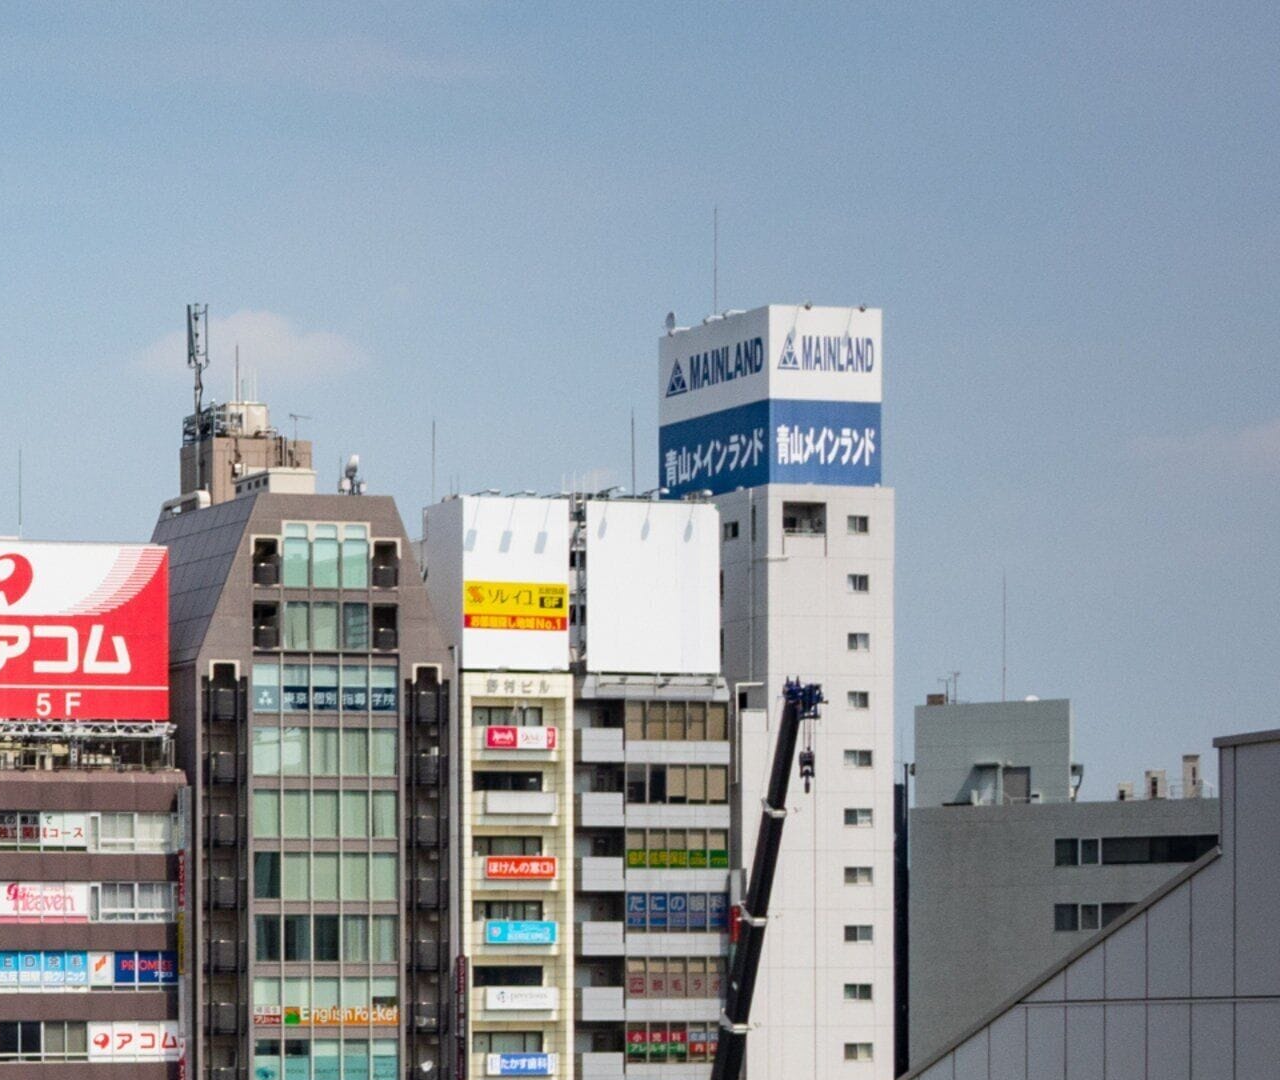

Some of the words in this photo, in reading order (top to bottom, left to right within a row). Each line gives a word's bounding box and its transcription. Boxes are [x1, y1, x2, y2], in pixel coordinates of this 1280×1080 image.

[802, 335, 874, 373] MAINLAND
[689, 337, 763, 391] MAINLAND
[776, 424, 875, 466] 青山メインランド
[664, 427, 764, 487] 青山メインランド
[36, 692, 82, 716] 5F
[283, 691, 396, 707] 東京個別指導学院
[488, 861, 548, 874] ほけんの窓口
[12, 891, 76, 911] Heaven
[629, 895, 726, 912] たにの眼科
[120, 959, 173, 972] PROMISE
[301, 1003, 353, 1022] English
[354, 1003, 398, 1021] Pocket
[116, 1032, 178, 1050] アコム
[501, 1057, 547, 1070] たかす歯科
